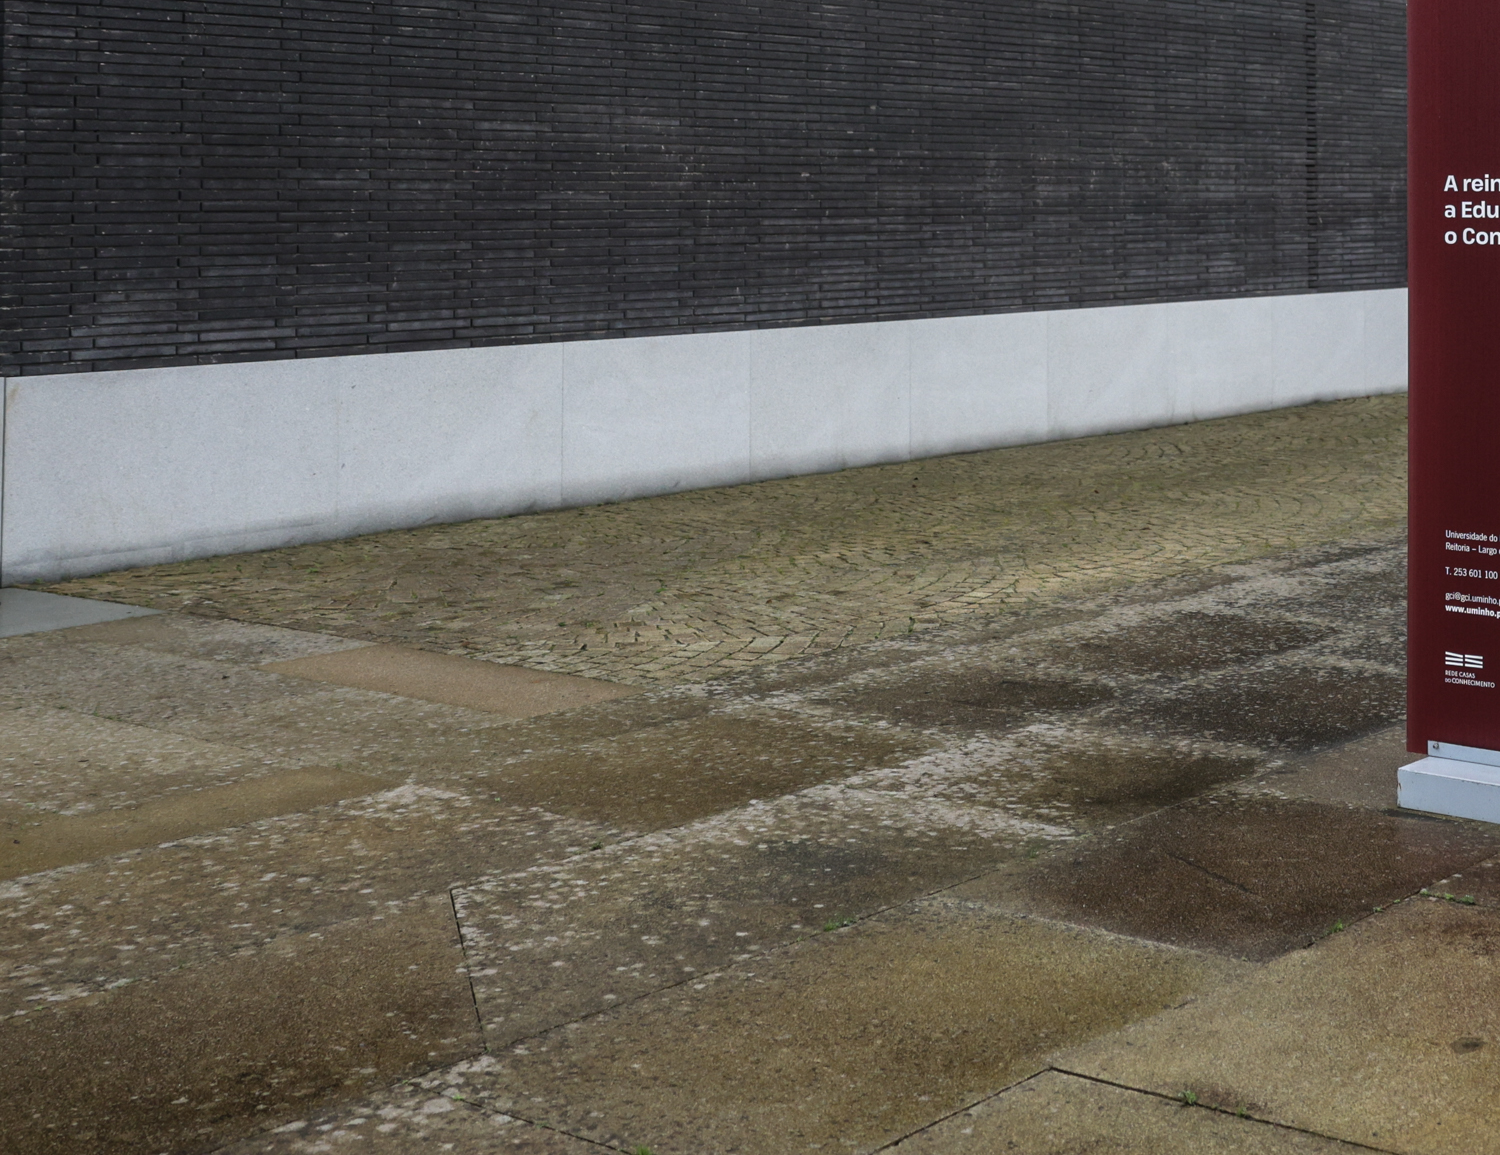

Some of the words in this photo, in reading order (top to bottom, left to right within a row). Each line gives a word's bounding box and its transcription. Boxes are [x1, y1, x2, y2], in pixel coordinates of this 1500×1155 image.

[1444, 175, 1458, 192] A
[1444, 204, 1456, 218] a
[1444, 231, 1457, 244] o
[1445, 529, 1488, 541] Universidade
[1489, 534, 1498, 542] do
[1445, 542, 1470, 552] Reitoria
[1478, 545, 1497, 556] Largo
[1445, 566, 1452, 575] T.
[1453, 567, 1467, 577] 253
[1468, 569, 1482, 578] 601
[1485, 570, 1498, 580] 100
